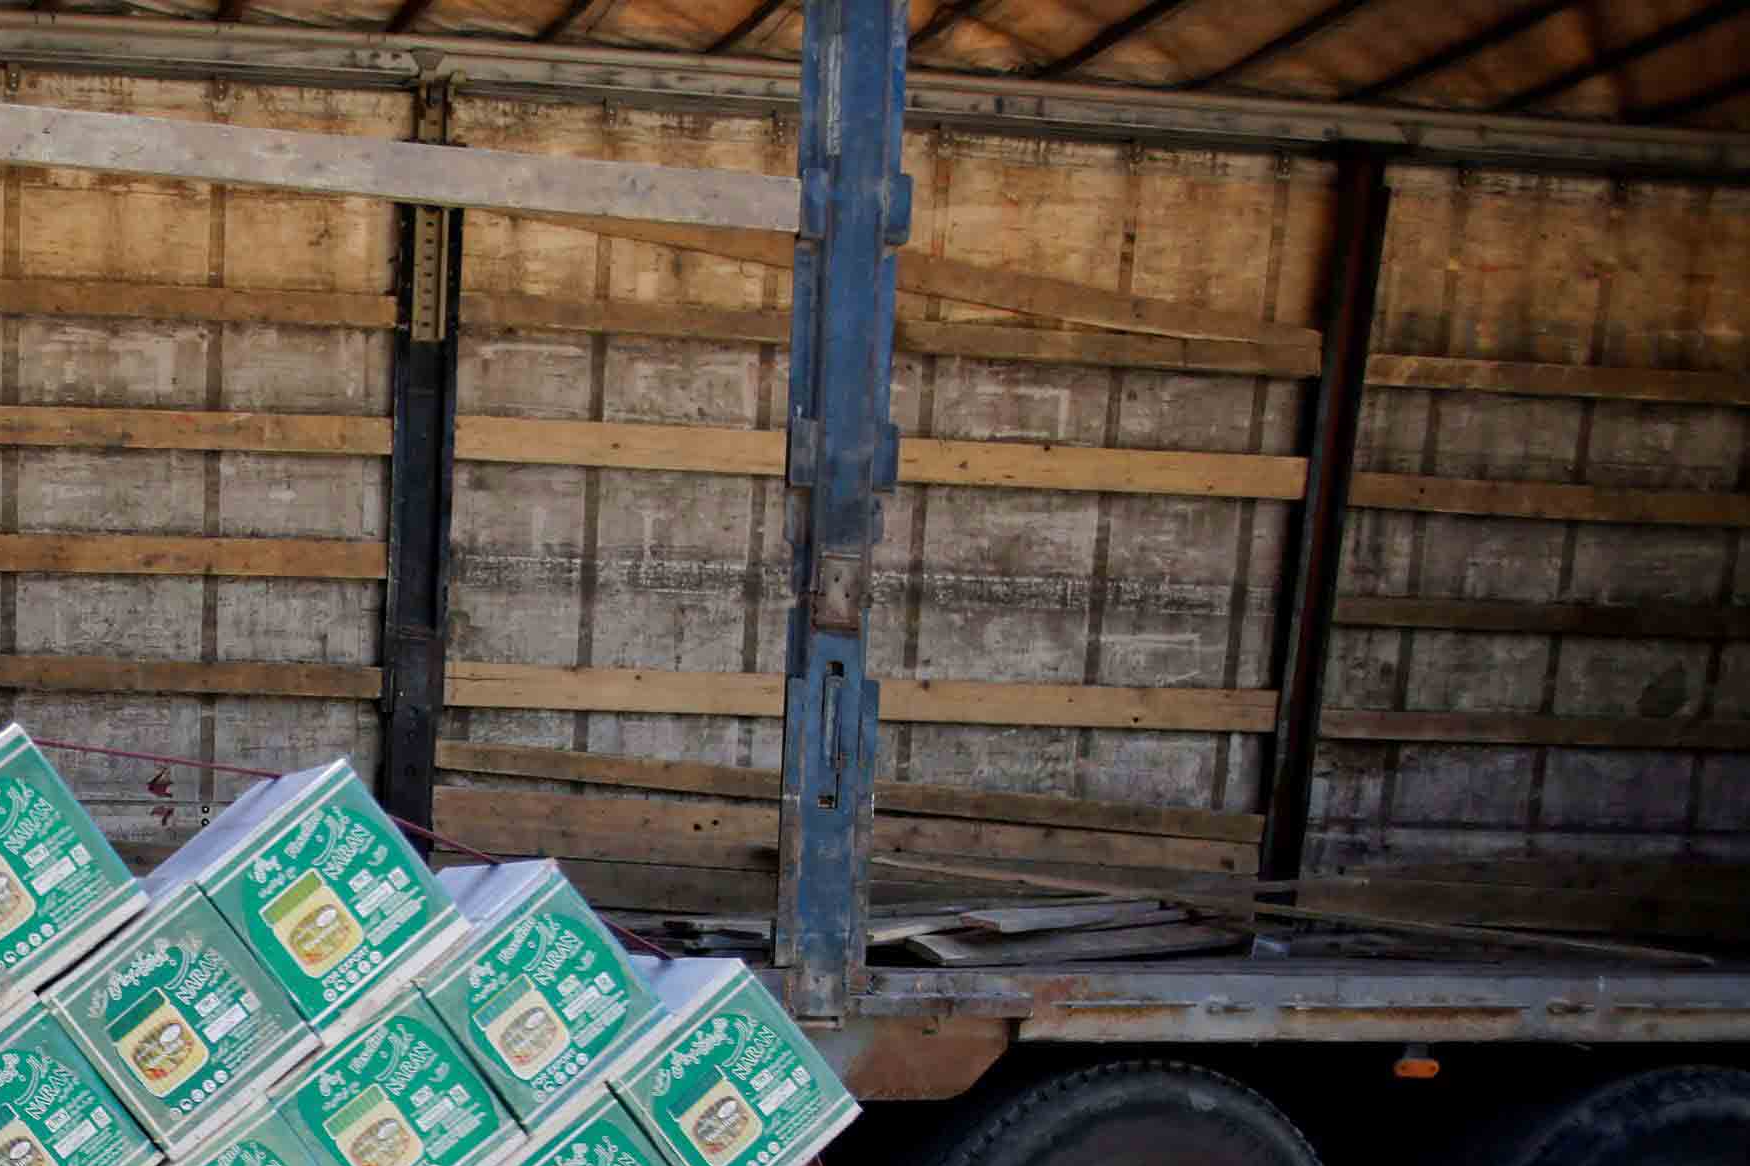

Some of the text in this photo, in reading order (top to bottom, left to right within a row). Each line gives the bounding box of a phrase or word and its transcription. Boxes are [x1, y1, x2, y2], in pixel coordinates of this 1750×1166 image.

[2, 797, 54, 854] NARAN
[322, 822, 370, 880] NARAN
[174, 947, 223, 1004] NARAN
[533, 928, 579, 985] NARAN
[385, 1039, 433, 1095] NARAN
[731, 1025, 776, 1080] NARAN
[23, 1063, 72, 1120] NARAN
